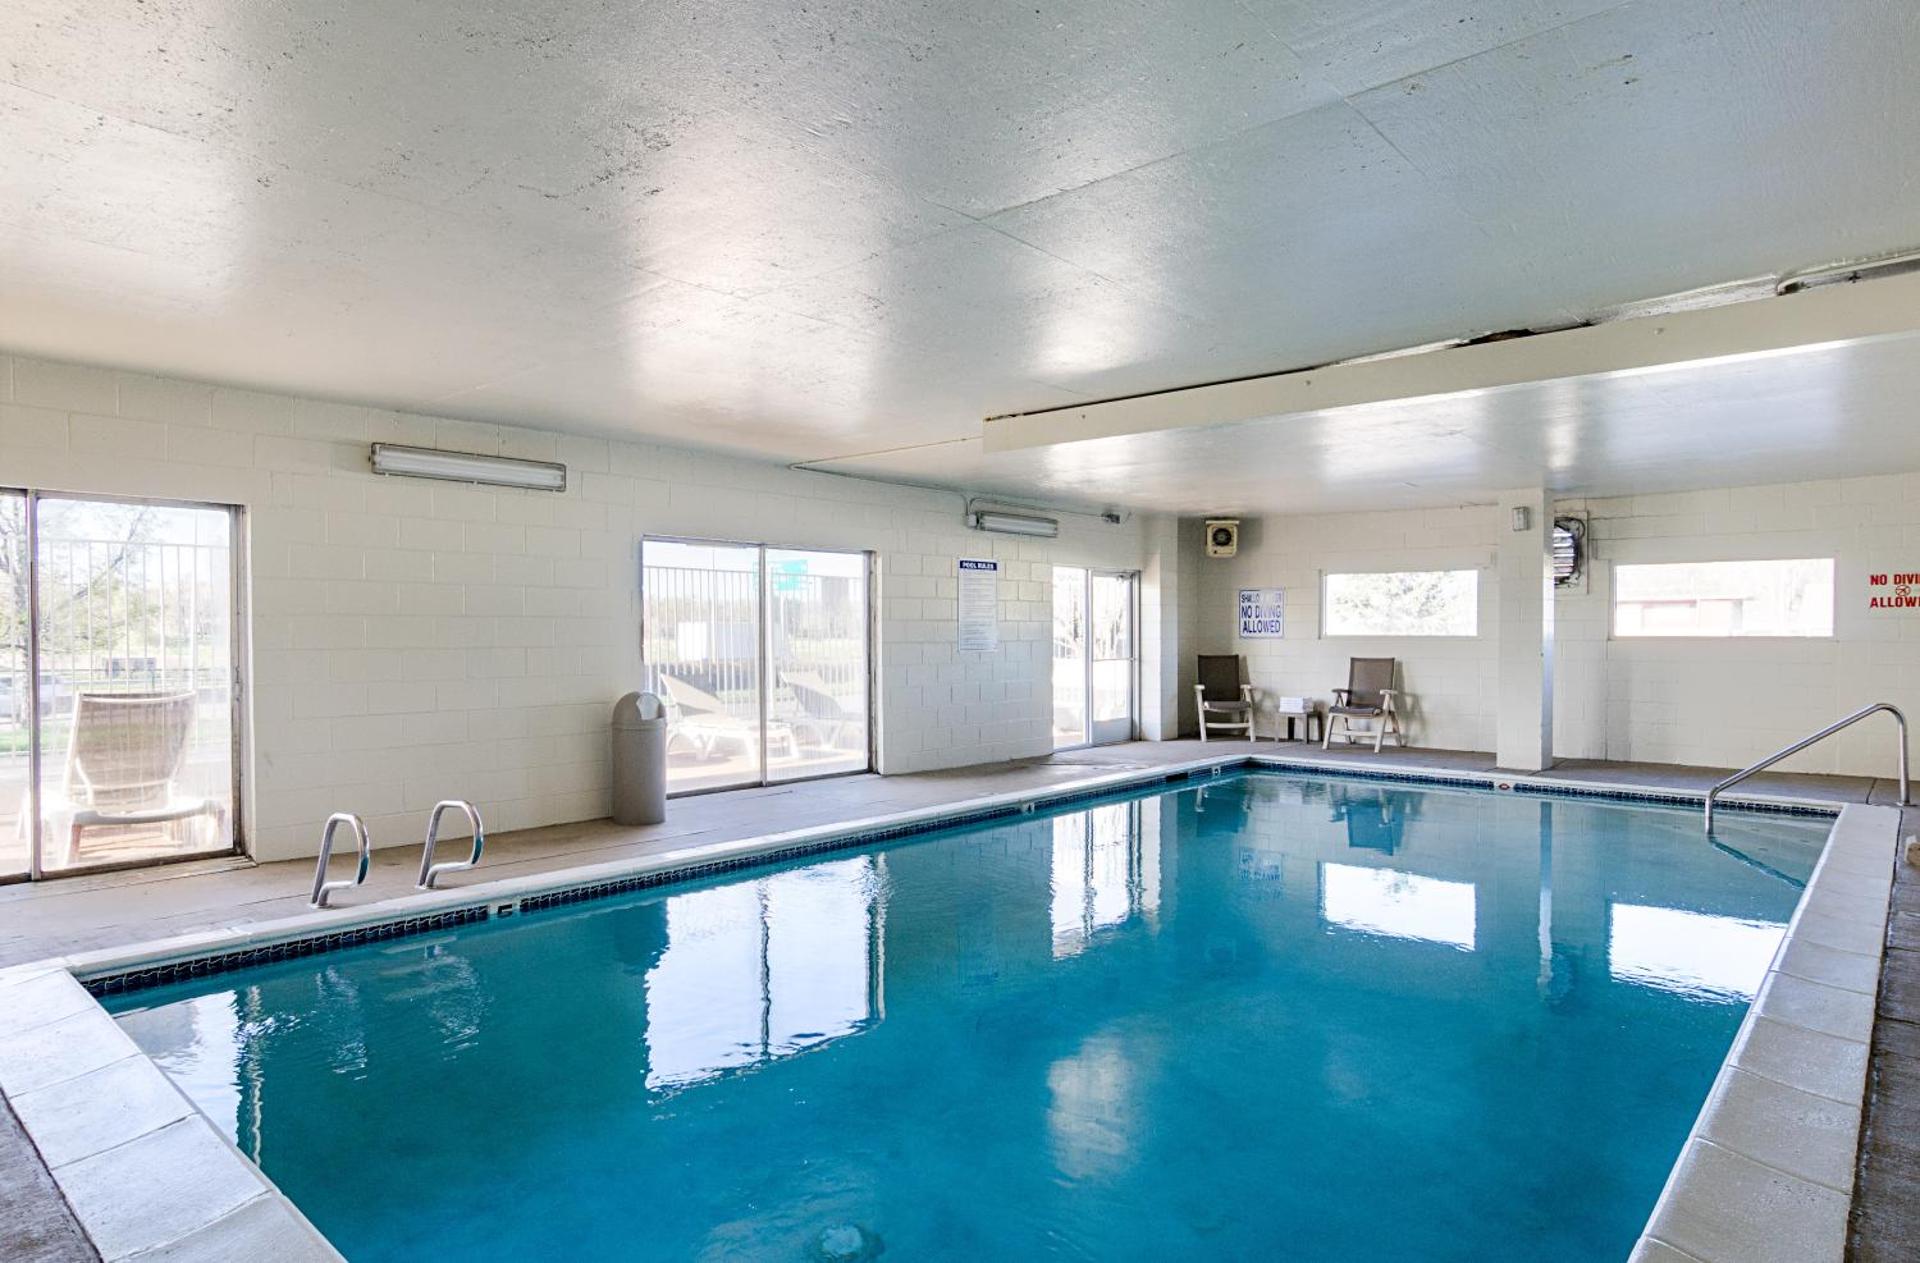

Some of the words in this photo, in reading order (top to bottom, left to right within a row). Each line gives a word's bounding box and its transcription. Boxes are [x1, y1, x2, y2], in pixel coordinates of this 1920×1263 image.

[1870, 574, 1888, 586] NO
[1893, 573, 1920, 585] DIVI
[1241, 593, 1262, 604] SHALLO
[1870, 596, 1920, 608] ALLOW
[1241, 605, 1252, 618] NO
[1255, 605, 1281, 618] DIVING
[1242, 620, 1281, 633] ALLOWED
